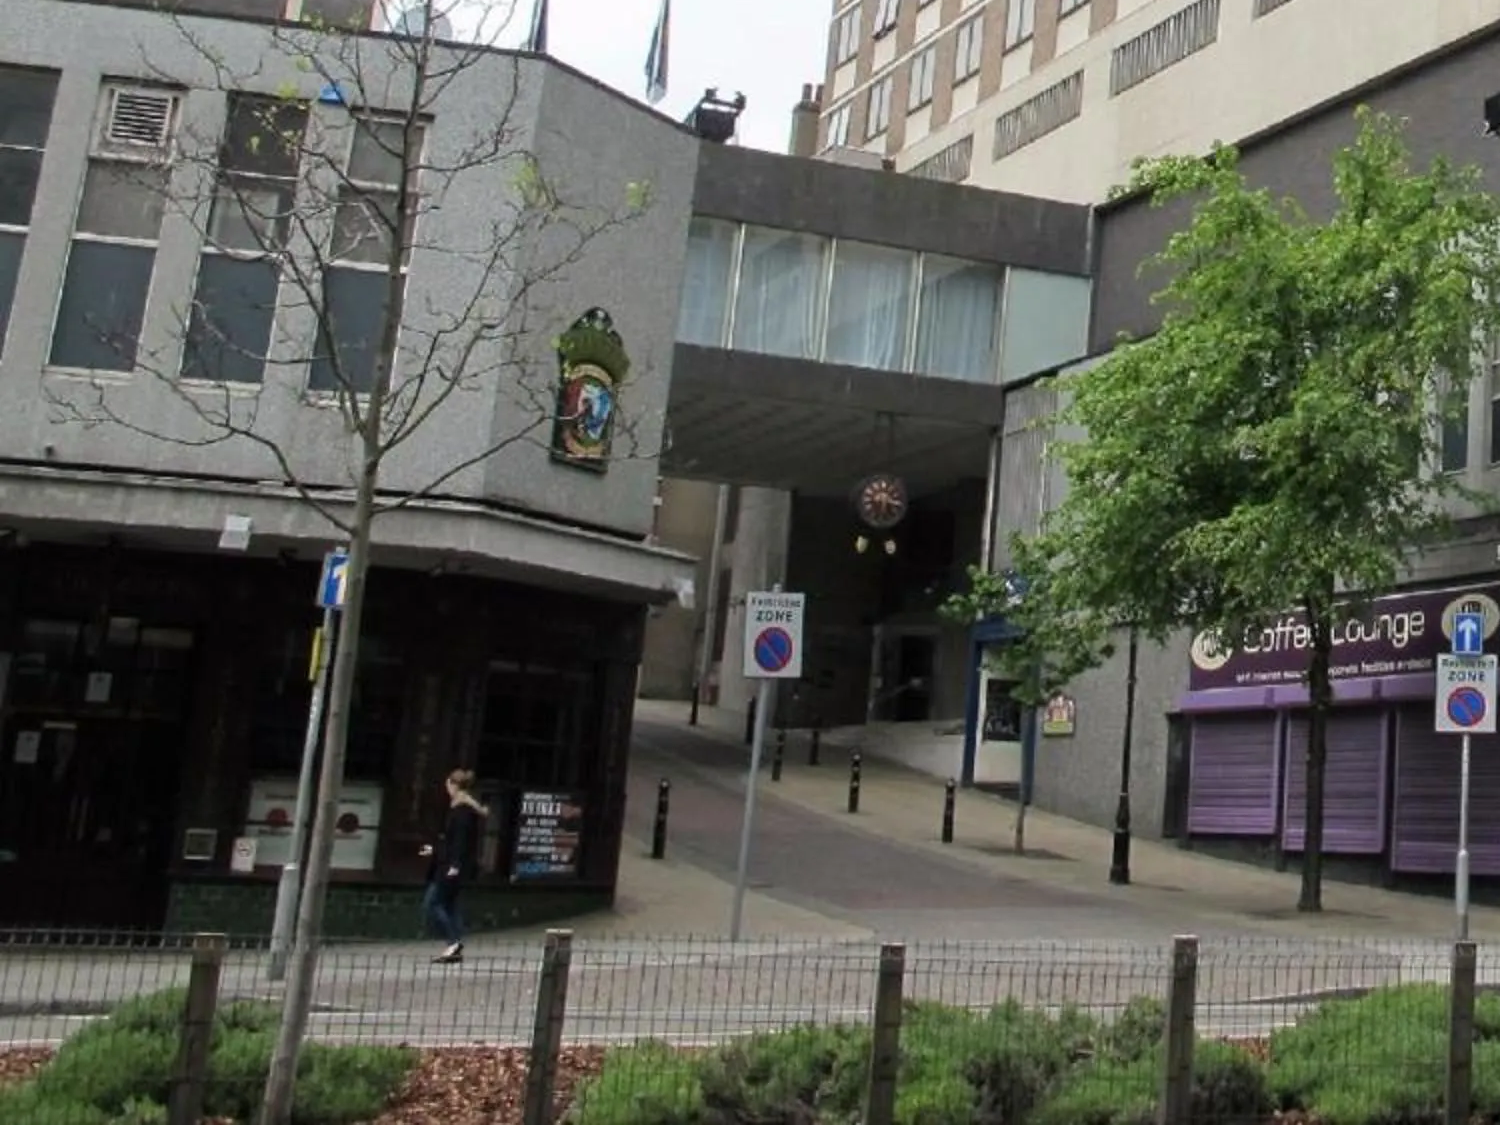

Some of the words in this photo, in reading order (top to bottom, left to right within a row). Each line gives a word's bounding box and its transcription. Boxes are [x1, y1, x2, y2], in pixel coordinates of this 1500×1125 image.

[756, 610, 793, 623] ZONE
[1243, 617, 1319, 653] Coffe
[1331, 611, 1425, 648] Lounge
[1447, 670, 1485, 682] ZONE
